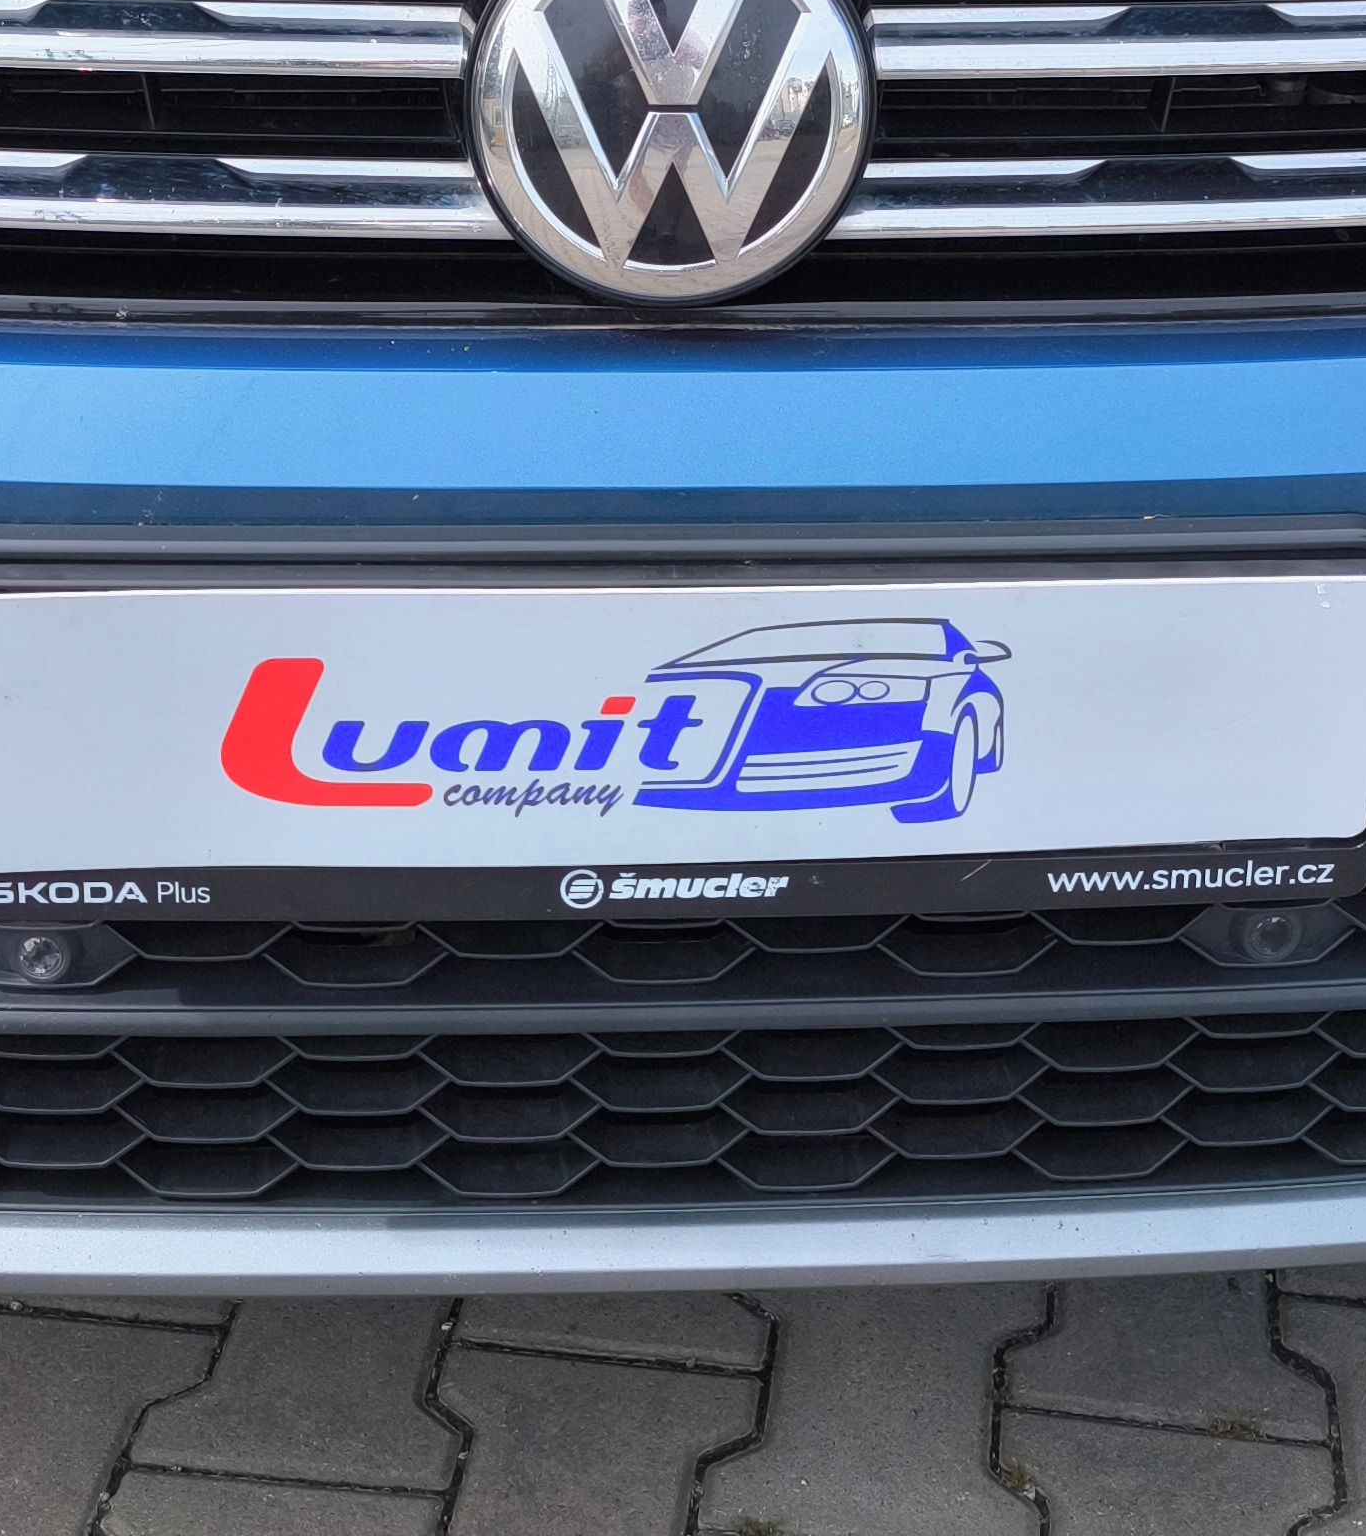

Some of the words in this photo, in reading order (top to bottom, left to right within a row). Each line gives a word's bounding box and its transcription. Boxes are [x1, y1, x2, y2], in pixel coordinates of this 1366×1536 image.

[219, 657, 704, 807] Lumit
[442, 777, 625, 817] company
[156, 880, 211, 904] Plus
[608, 871, 790, 900] šmucler
[1046, 859, 1335, 893] www.smucler.cz
